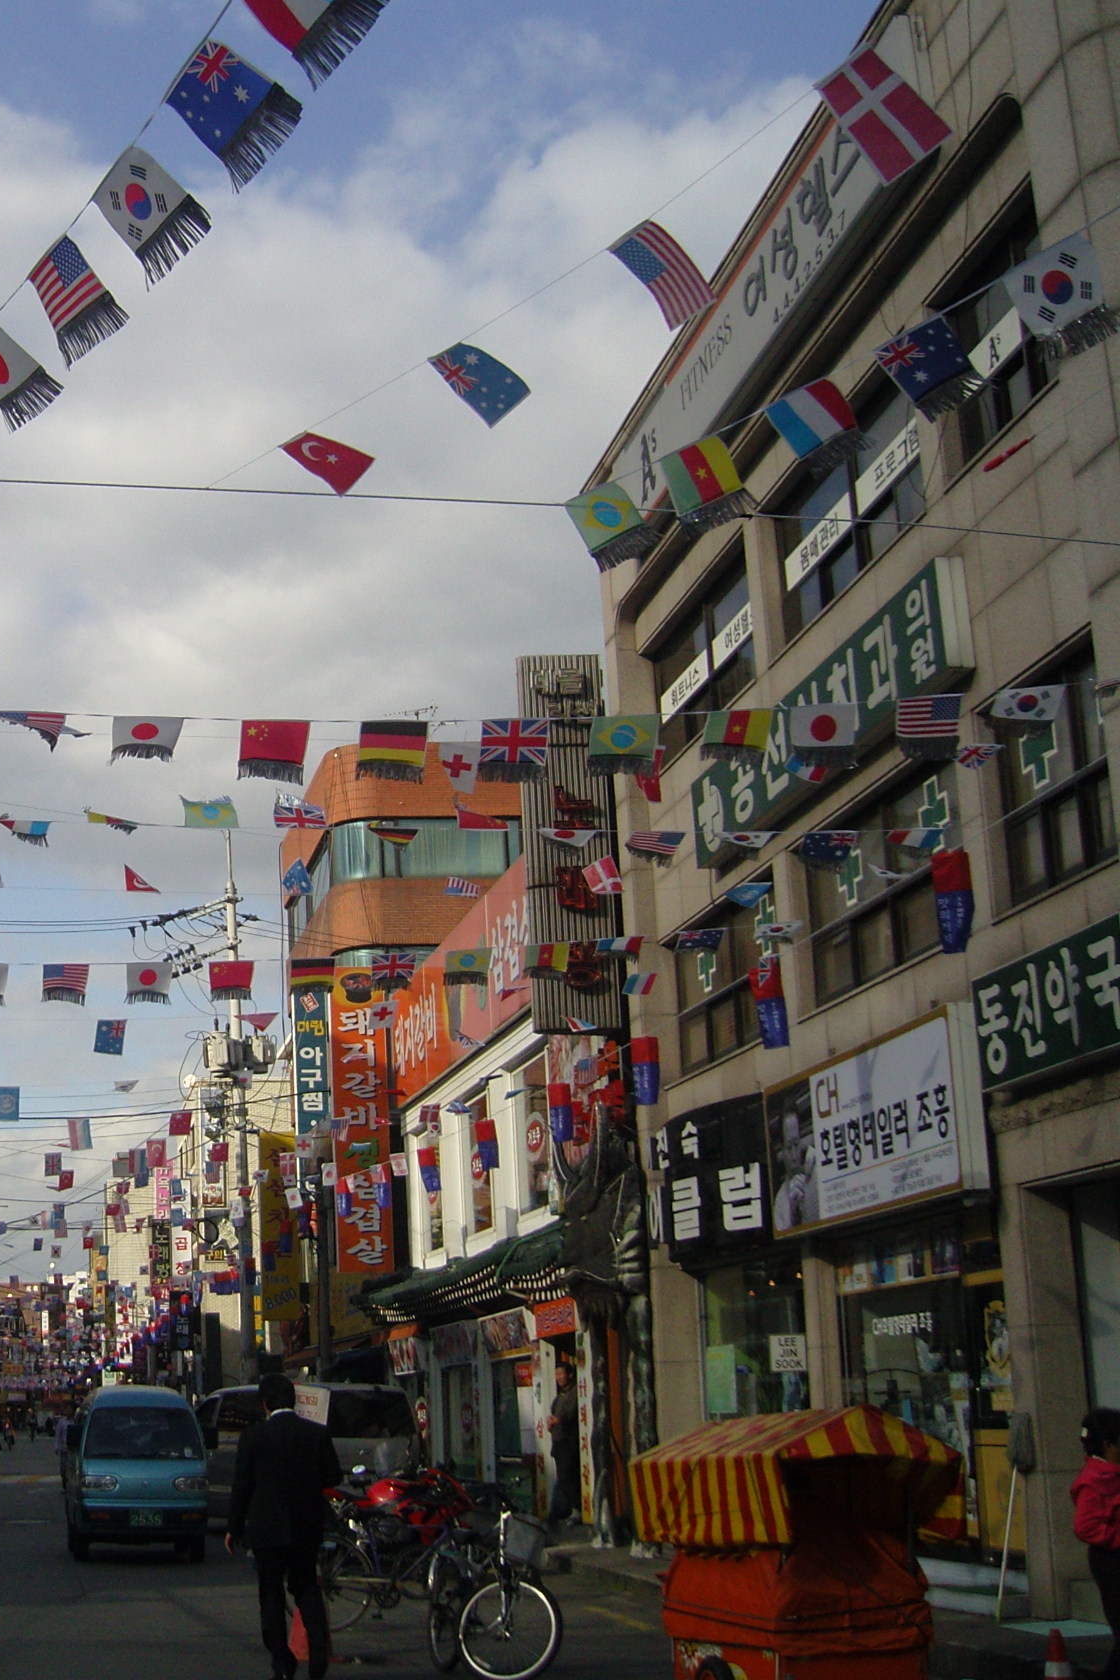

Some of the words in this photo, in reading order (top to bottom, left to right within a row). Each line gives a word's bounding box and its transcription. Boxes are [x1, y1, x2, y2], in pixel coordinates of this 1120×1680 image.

[678, 313, 734, 411] FITNESS
[724, 608, 752, 649] 여성헬
[394, 982, 438, 1077] 돼지갈비
[978, 935, 1120, 1075] 동진약국
[298, 1045, 323, 1112] 아구찜
[337, 1008, 382, 1131] 돼지갈비
[775, 1359, 804, 1369] SOOK
[778, 1337, 797, 1347] LEE
[779, 1349, 798, 1358] JIN
